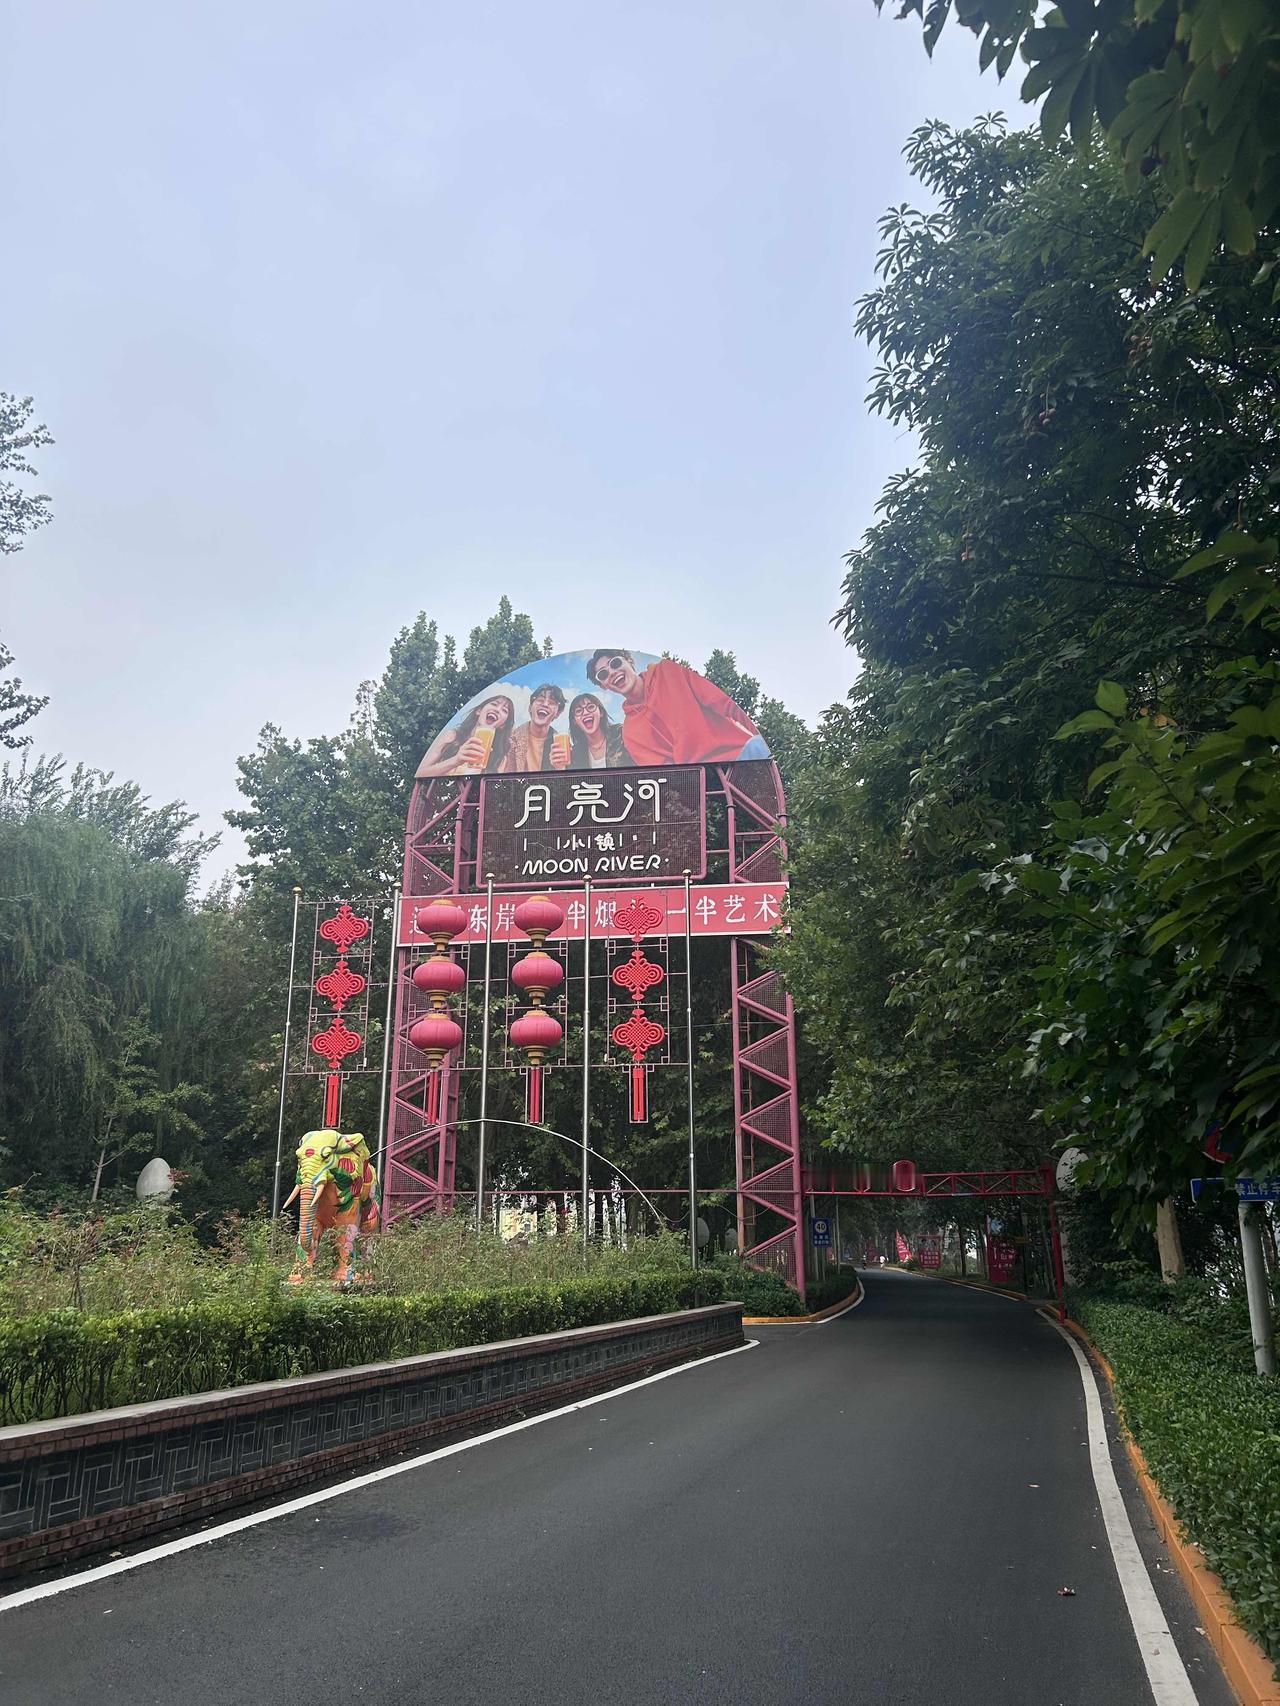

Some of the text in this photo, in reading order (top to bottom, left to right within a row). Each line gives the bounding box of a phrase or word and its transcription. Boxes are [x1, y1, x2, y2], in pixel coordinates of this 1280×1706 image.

[513, 777, 667, 829] 月亮河
[562, 832, 616, 852] 小镇
[521, 854, 662, 876] MOON RIVER
[816, 1223, 826, 1231] 40
